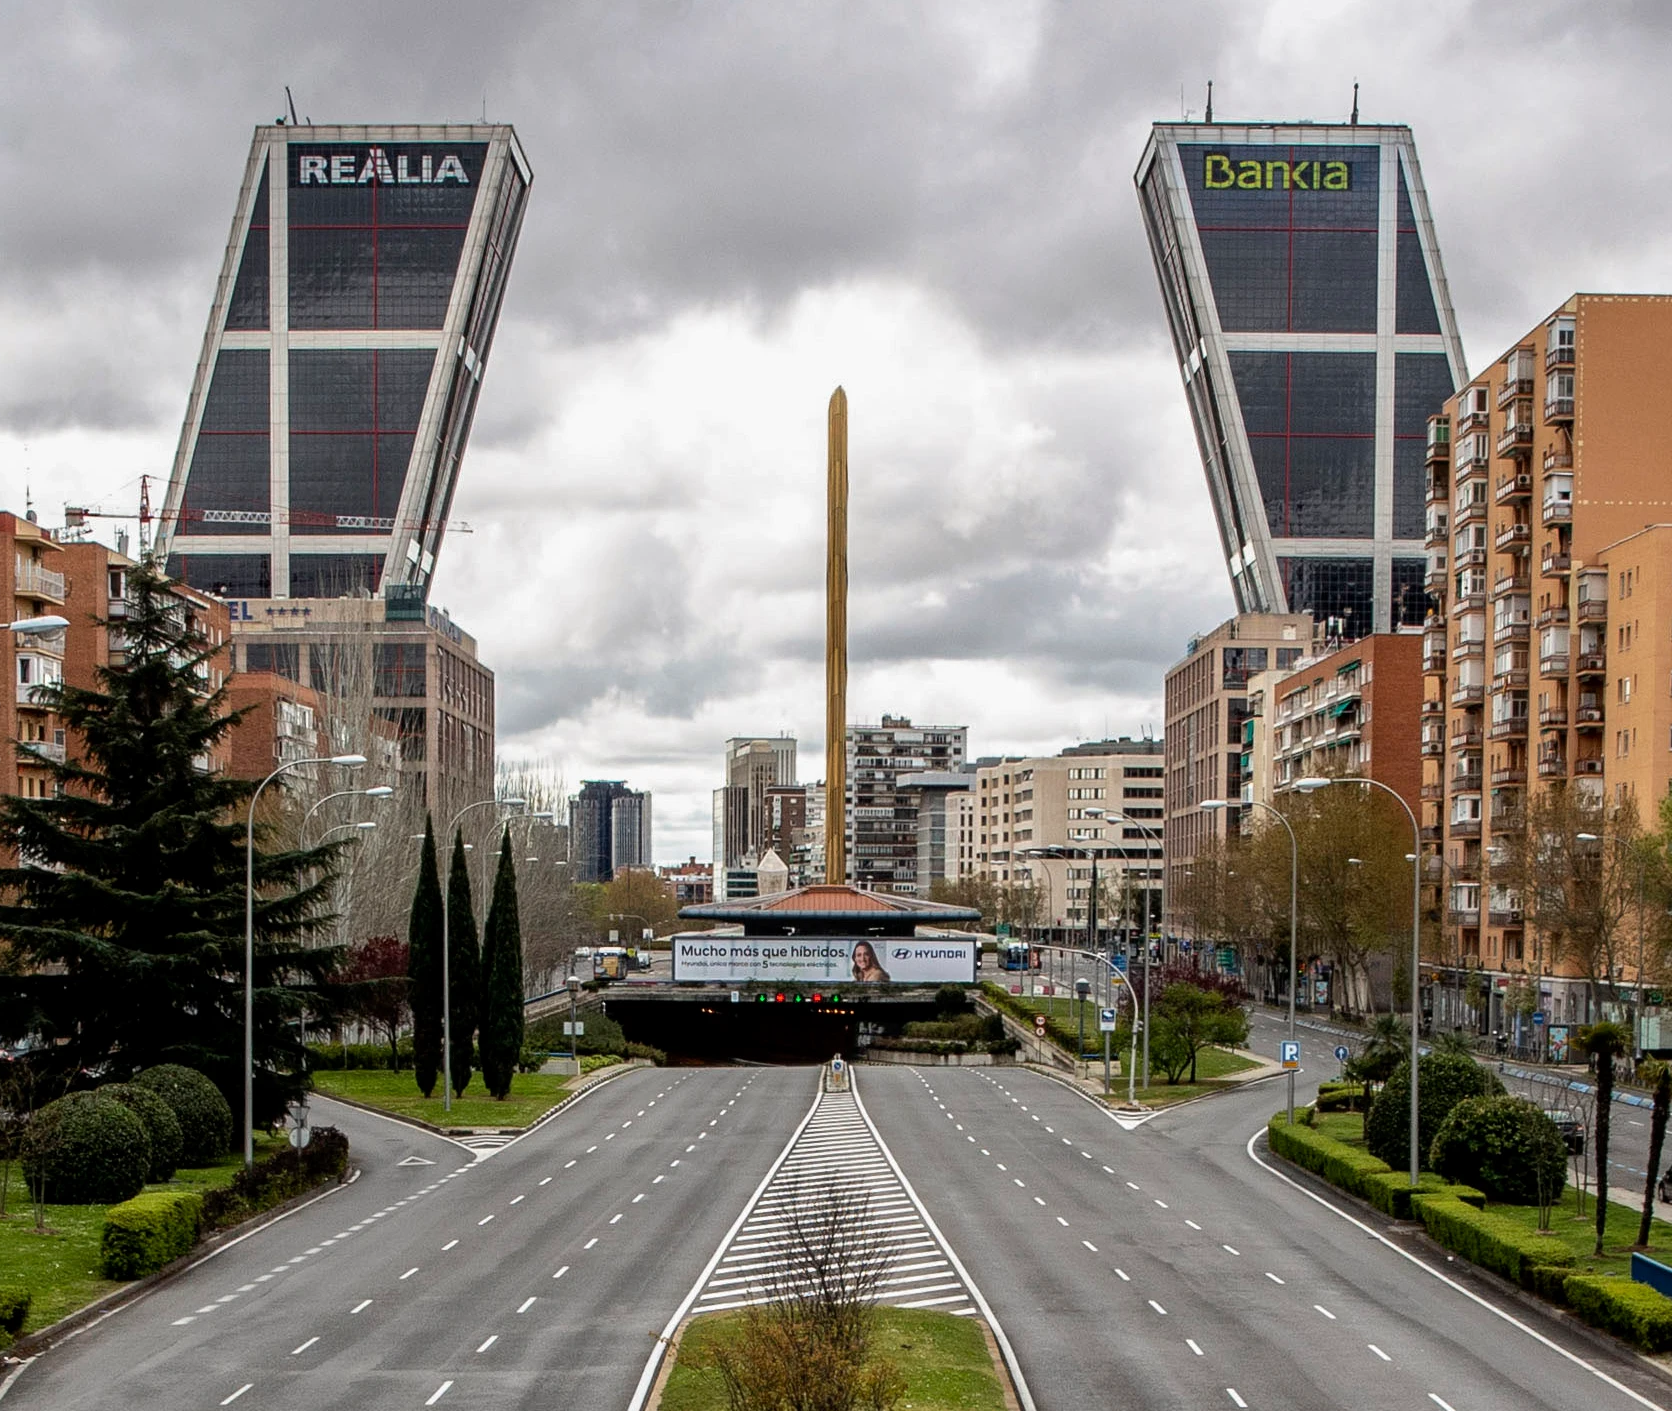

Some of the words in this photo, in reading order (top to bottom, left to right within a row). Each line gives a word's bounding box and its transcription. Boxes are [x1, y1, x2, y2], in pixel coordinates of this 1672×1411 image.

[300, 148, 469, 184] REALIA
[1204, 155, 1349, 190] Bankia
[681, 945, 727, 957] Mucho
[730, 945, 759, 957] más
[762, 948, 788, 959] que
[791, 945, 849, 957] híbridos.
[915, 950, 966, 959] HYUNDAI
[762, 960, 769, 968] 5
